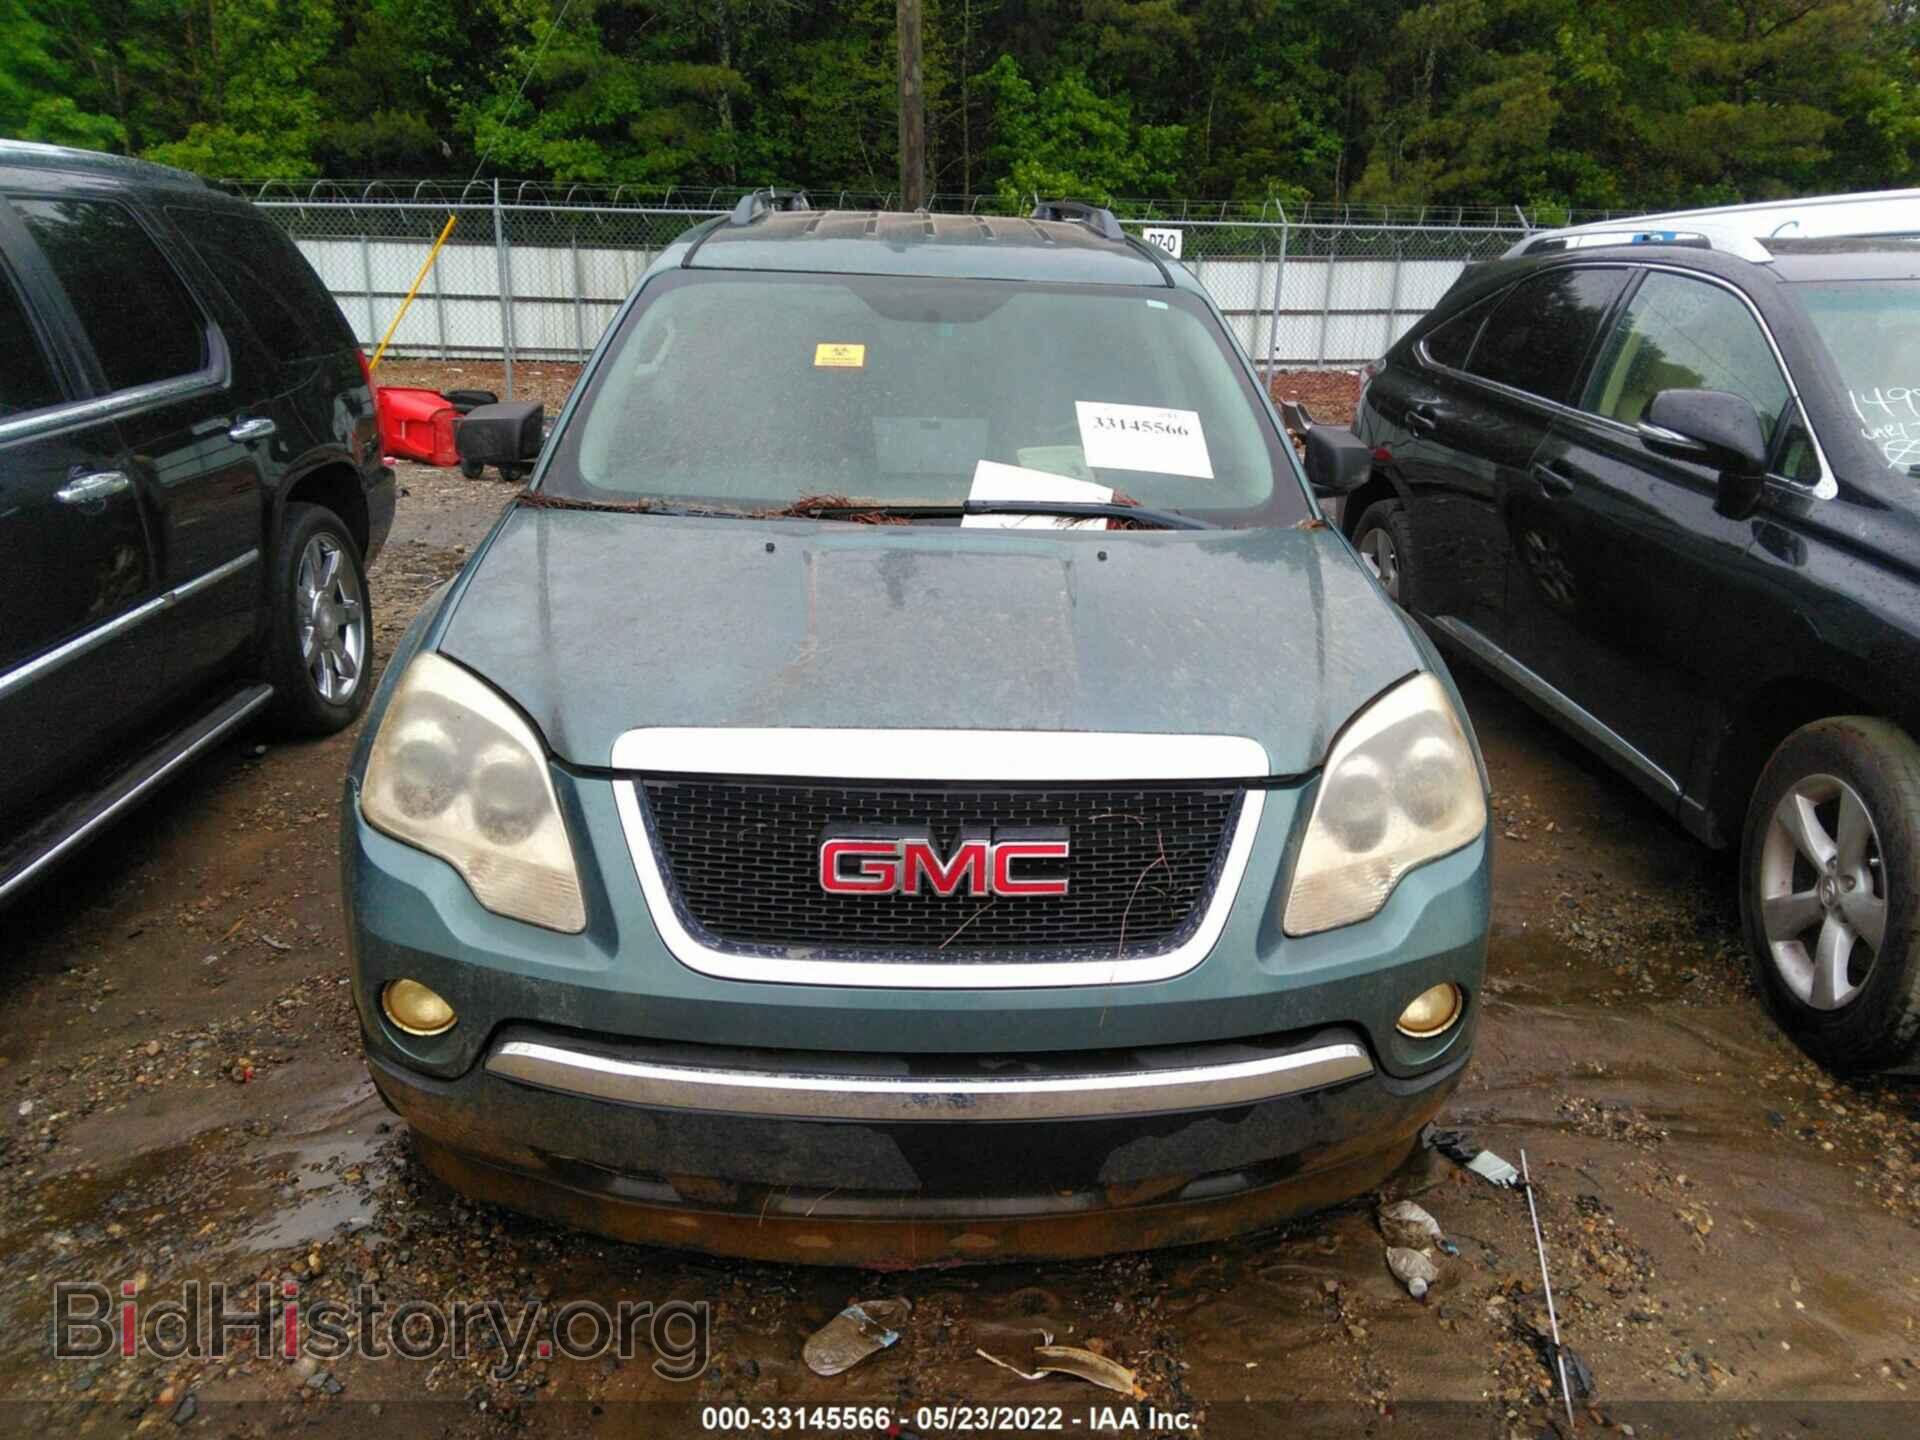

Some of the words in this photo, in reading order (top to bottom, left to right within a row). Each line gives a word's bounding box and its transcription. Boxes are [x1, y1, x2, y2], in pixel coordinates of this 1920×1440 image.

[1848, 386, 1920, 422] 149
[1093, 416, 1190, 437] 33145566
[820, 837, 1070, 896] GMC
